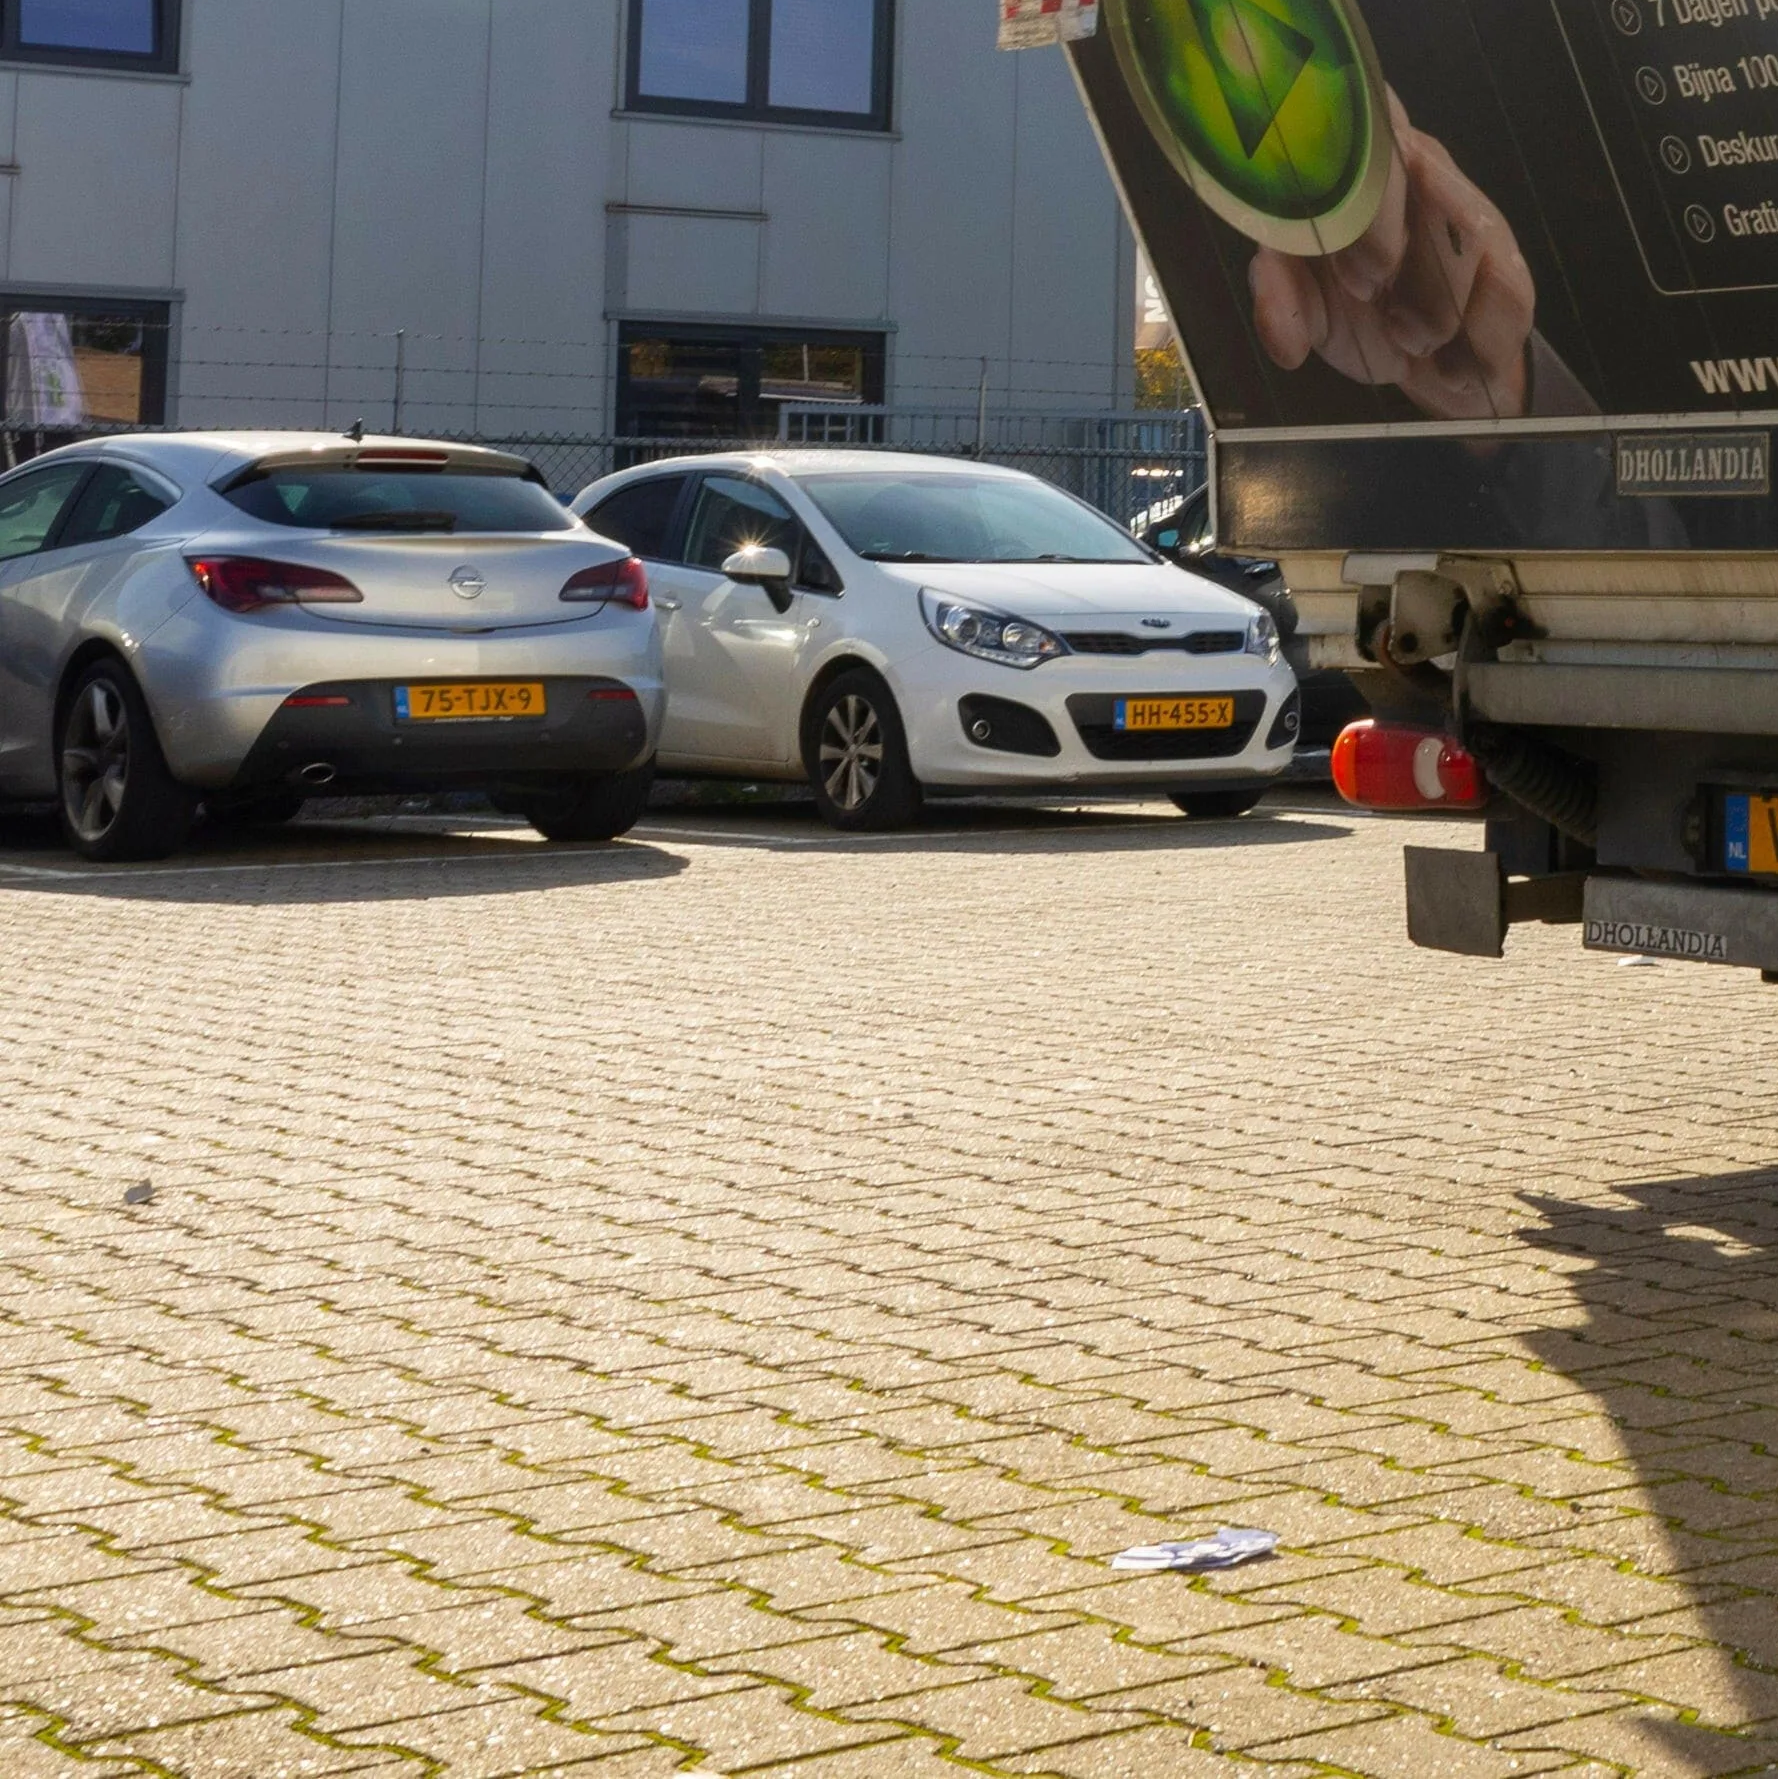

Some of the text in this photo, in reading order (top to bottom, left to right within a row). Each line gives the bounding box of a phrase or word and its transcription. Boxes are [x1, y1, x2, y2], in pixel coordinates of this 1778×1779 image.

[1673, 56, 1737, 102] Bijna
[1619, 446, 1767, 483] DHOLLANDIA
[419, 687, 532, 713] 75-TJX-9
[1132, 701, 1229, 725] HH-455-X
[1586, 921, 1726, 959] DHOLLANDIA
